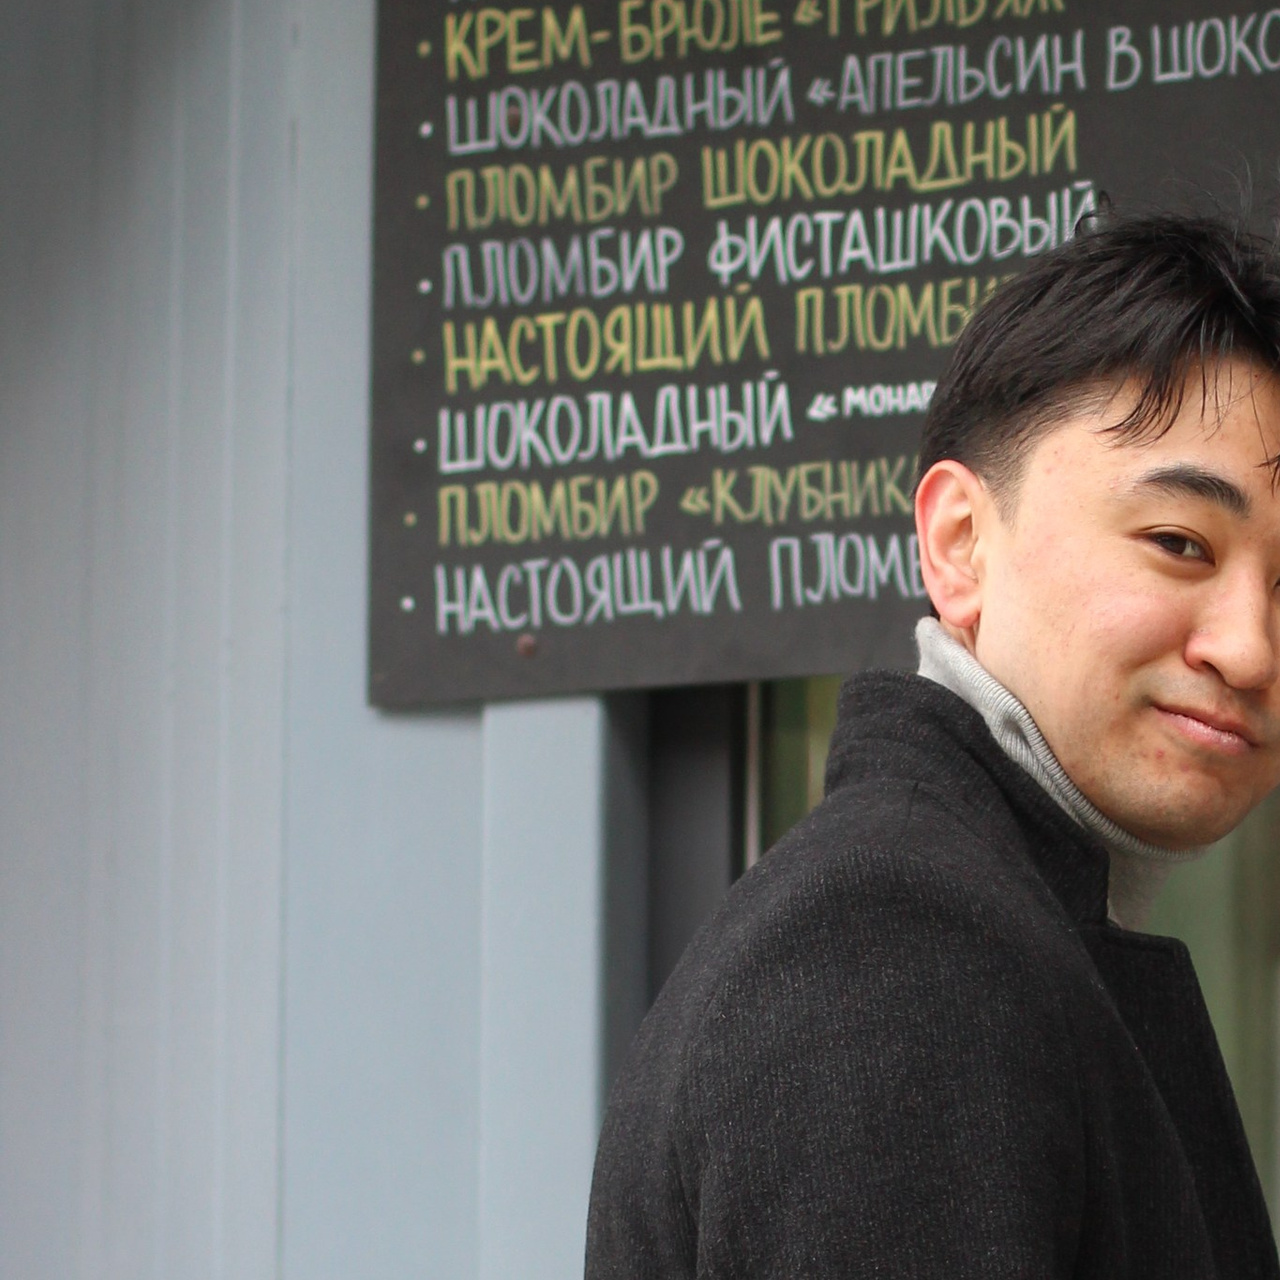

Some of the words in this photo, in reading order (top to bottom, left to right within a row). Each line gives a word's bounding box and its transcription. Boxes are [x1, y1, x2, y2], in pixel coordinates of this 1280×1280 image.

[446, 58, 792, 155] ШОКОЛАДНЫЙ
[1106, 26, 1142, 90] В
[446, 154, 675, 229] ПЛОМБИР
[703, 103, 1077, 207] ШОКОЛАДНЫЙ
[443, 227, 682, 308] ПЛОМБИР
[708, 180, 1098, 284] ФИСТАШКОВЫЙ
[443, 284, 769, 393] НАСТОЯЩИЙ
[796, 273, 1020, 354] ПЛОМБ
[438, 370, 793, 474] ШОКОЛАДНЫЙ
[807, 380, 938, 420] «МОНАР
[438, 472, 657, 545] ПЛОМБИР
[680, 454, 920, 526] «КЛУБНИК
[435, 539, 742, 634] НАСТОЯЩИЙ
